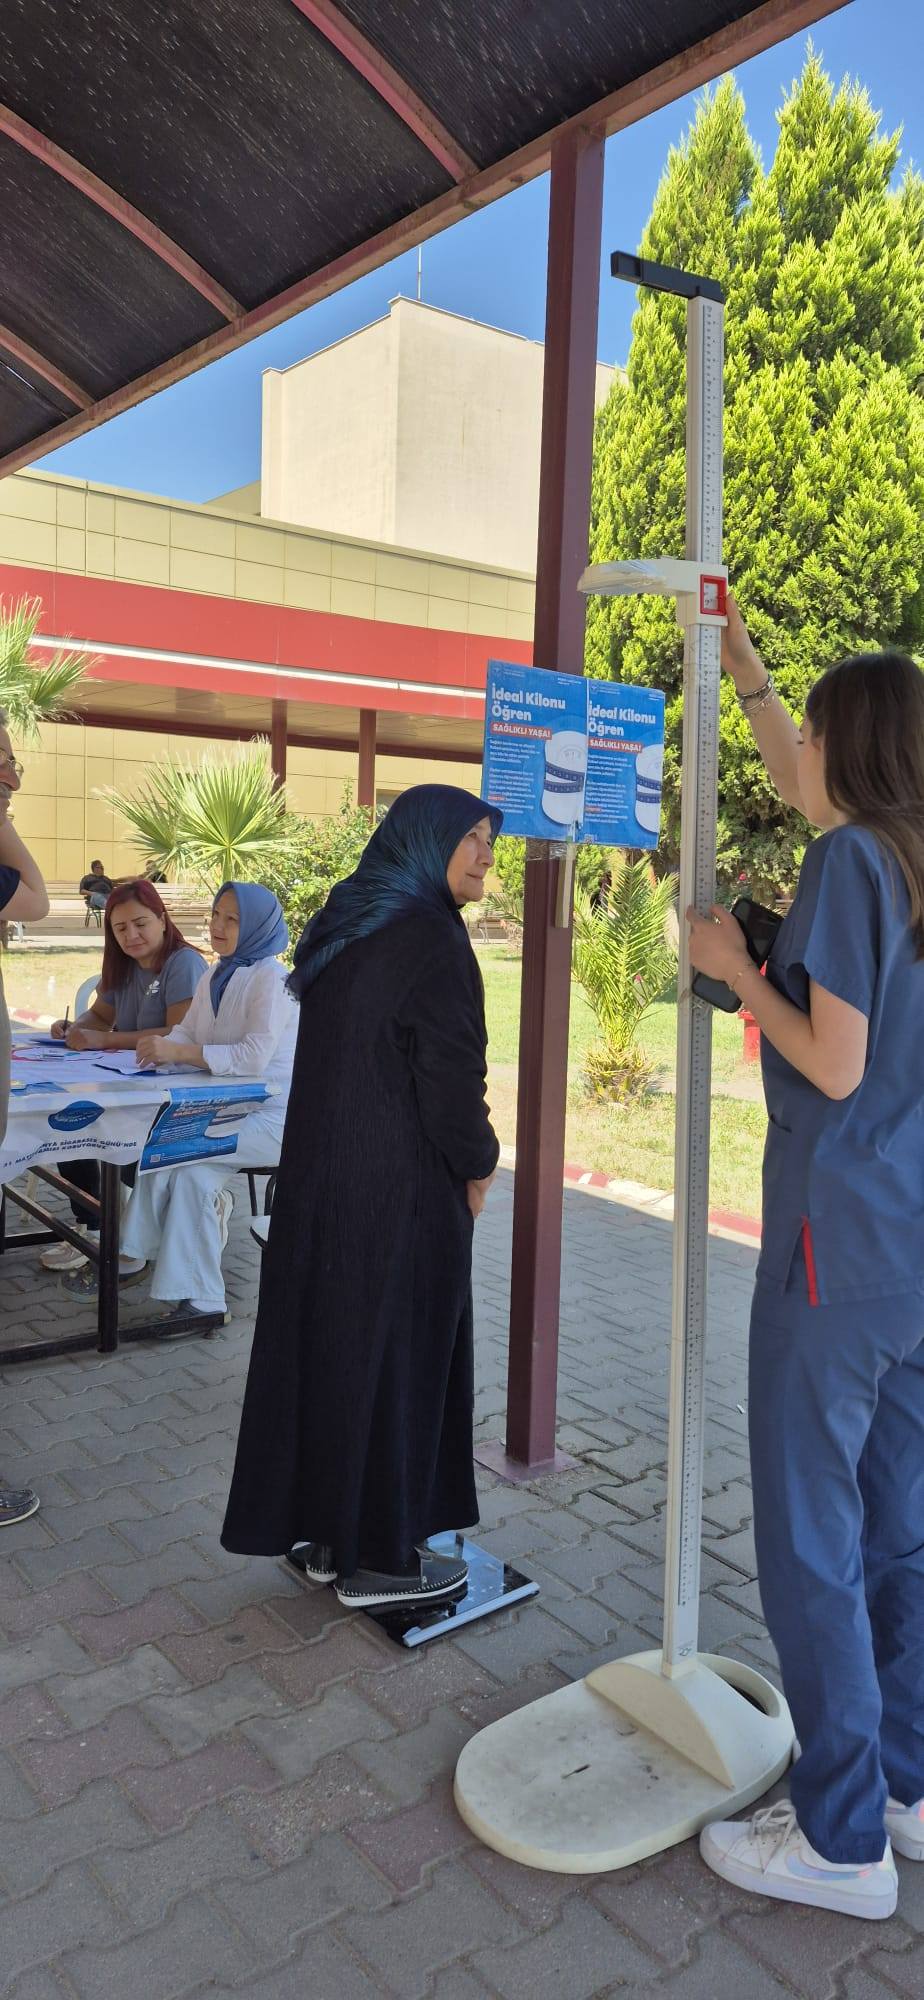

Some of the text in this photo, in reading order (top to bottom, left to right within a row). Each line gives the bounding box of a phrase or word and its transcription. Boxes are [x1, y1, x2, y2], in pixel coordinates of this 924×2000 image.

[492, 682, 566, 709] İdeal Kilonu
[491, 701, 532, 721] Öğren
[589, 701, 656, 724] İdeal Kilonu
[493, 723, 551, 738] SAĞLIKLI YAŞA!
[589, 717, 624, 736] Öğren
[590, 739, 641, 752] SAĞLIKLI YAŞA!
